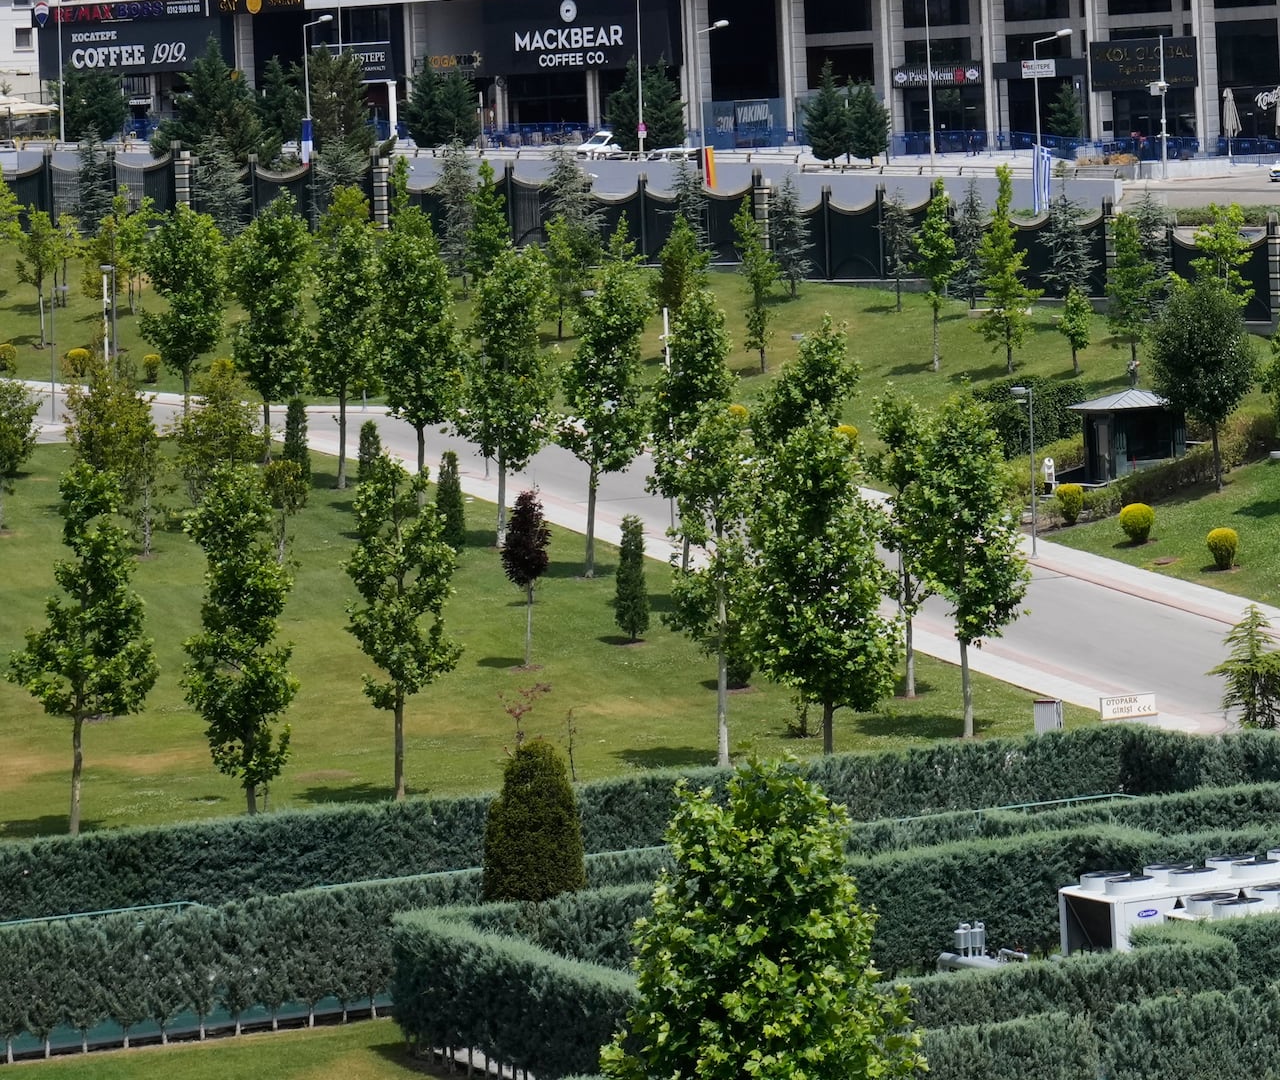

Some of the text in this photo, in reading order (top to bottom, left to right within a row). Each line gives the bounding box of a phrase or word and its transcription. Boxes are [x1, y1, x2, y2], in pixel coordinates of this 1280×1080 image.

[117, 0, 164, 18] BOSS
[72, 31, 117, 43] KOCATEPE
[514, 25, 623, 51] MACKBEAR
[72, 45, 145, 69] COFFEE
[352, 52, 386, 65] EŞTEPE
[539, 51, 609, 67] COFFEE CO.
[1106, 697, 1138, 705] OTOPARK
